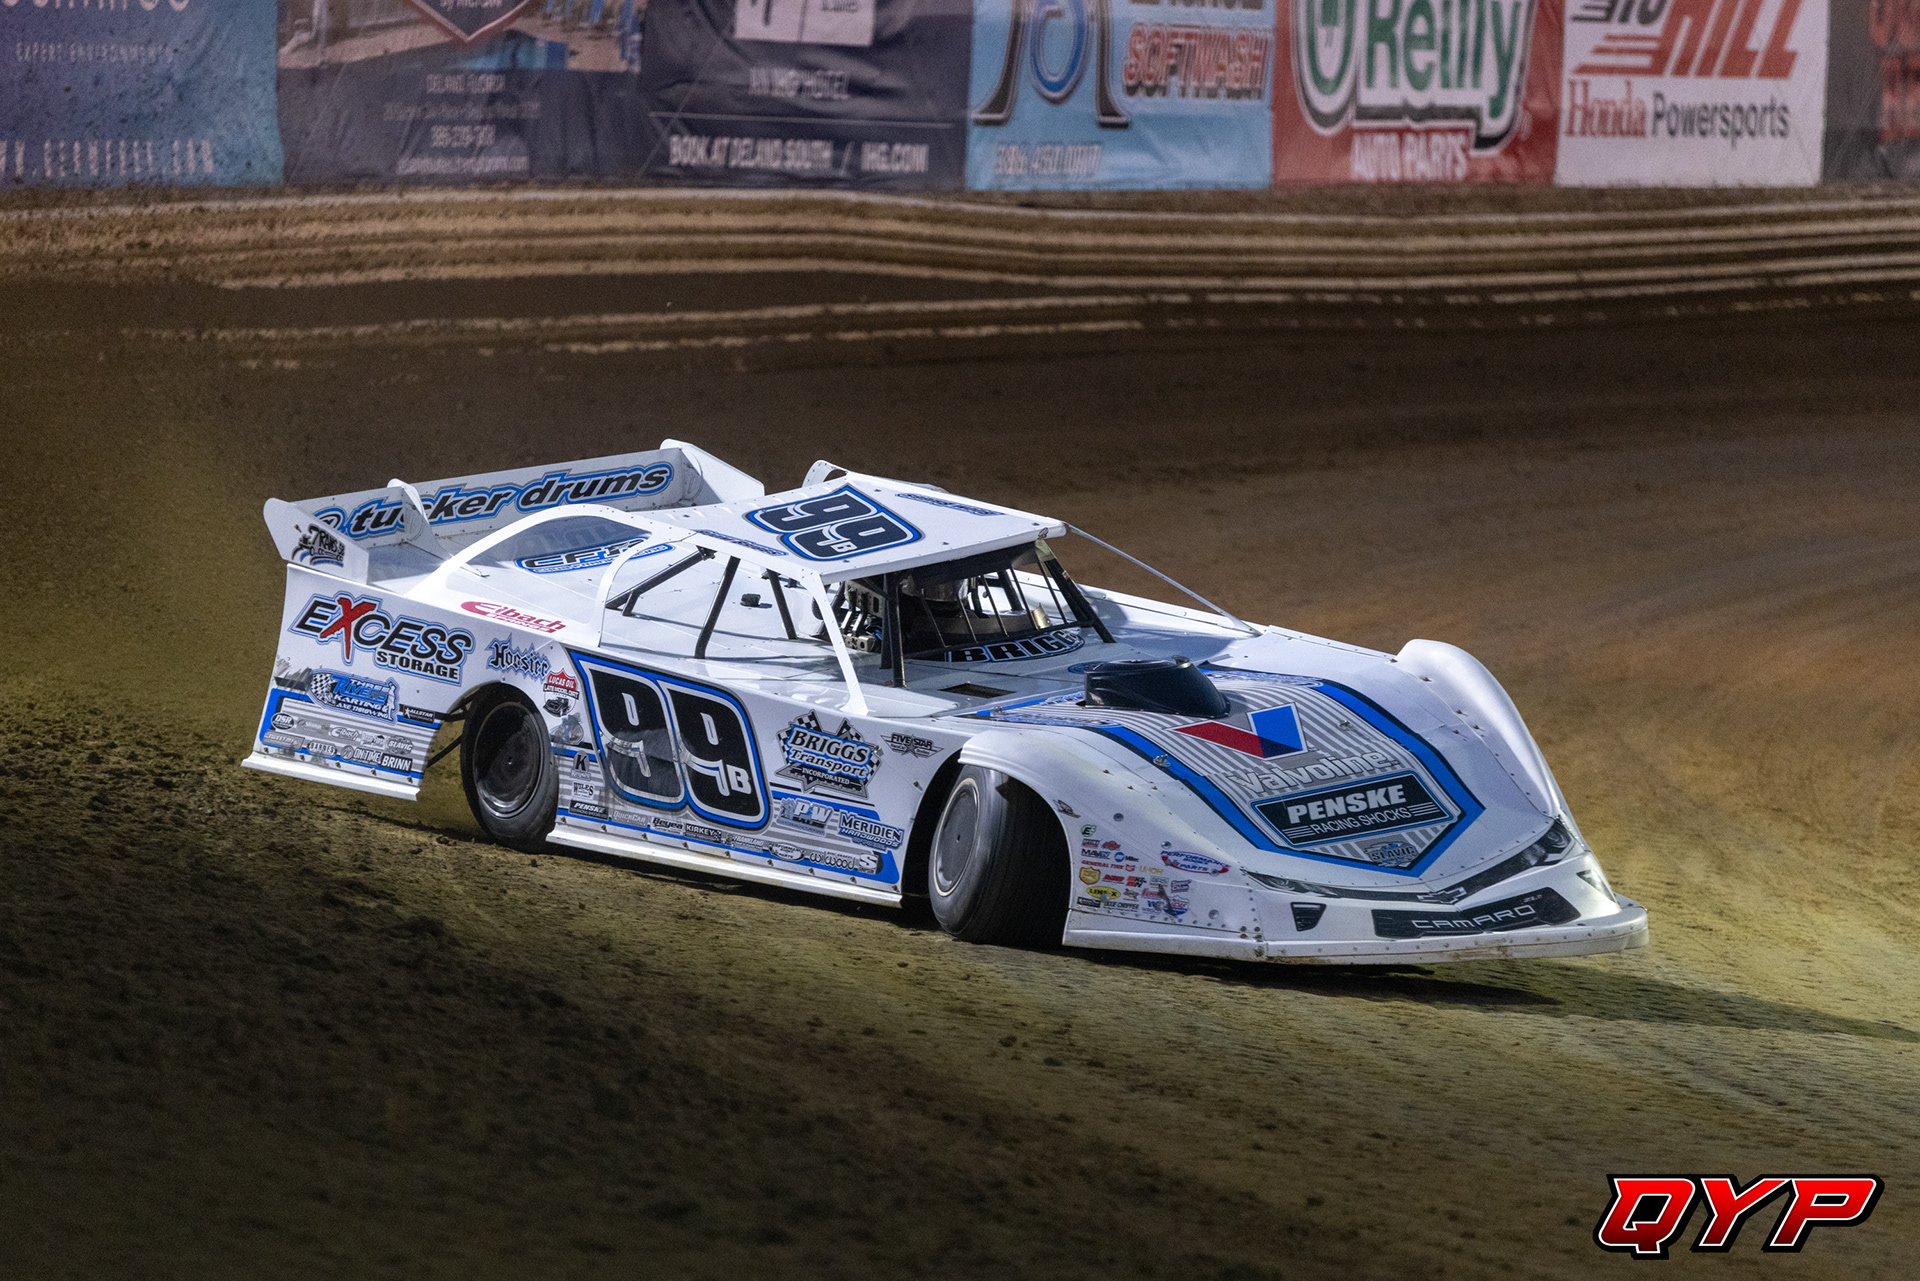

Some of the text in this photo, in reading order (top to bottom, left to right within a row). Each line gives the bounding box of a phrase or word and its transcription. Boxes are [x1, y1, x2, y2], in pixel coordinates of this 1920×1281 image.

[1565, 79, 1790, 148] Honda Powersports
[1351, 132, 1467, 181] AUTO PARTS
[354, 488, 516, 535] tuker
[522, 467, 668, 509] drums
[461, 601, 566, 630] Eibach
[296, 598, 471, 664] EXCESS
[377, 651, 459, 680] STORAGE
[490, 641, 548, 677] Hoosier
[351, 679, 390, 693] THREE
[549, 675, 575, 689] LUCAS OIL
[334, 694, 381, 710] KARTING
[337, 702, 389, 719] AXE THROWING
[410, 708, 433, 717] ALLSTAR
[331, 727, 359, 741] Eibach
[891, 733, 933, 750] FIVE STAR
[388, 740, 413, 751] SLAVIC
[791, 729, 869, 764] BRIGGS
[381, 755, 412, 771] BRINN
[575, 755, 587, 771] K
[790, 750, 869, 779] Transport
[801, 768, 850, 785] INCORPORATED
[1228, 752, 1389, 794] Valvoline
[573, 782, 594, 796] WILES
[573, 802, 607, 814] PENSKE
[1287, 785, 1406, 824] PENSKE
[652, 818, 683, 830] Beyea
[842, 813, 902, 843] MERIDIEN
[1312, 807, 1412, 835] RACING SHOCKS
[686, 824, 715, 836] KIRKEY
[841, 828, 901, 849] HARDWOODS
[810, 852, 857, 870] wilwood
[1081, 860, 1109, 868] GENERAL
[1161, 850, 1231, 868] PERFORMANCE
[1180, 863, 1209, 872] PARTS
[1411, 904, 1536, 929] CAMARO
